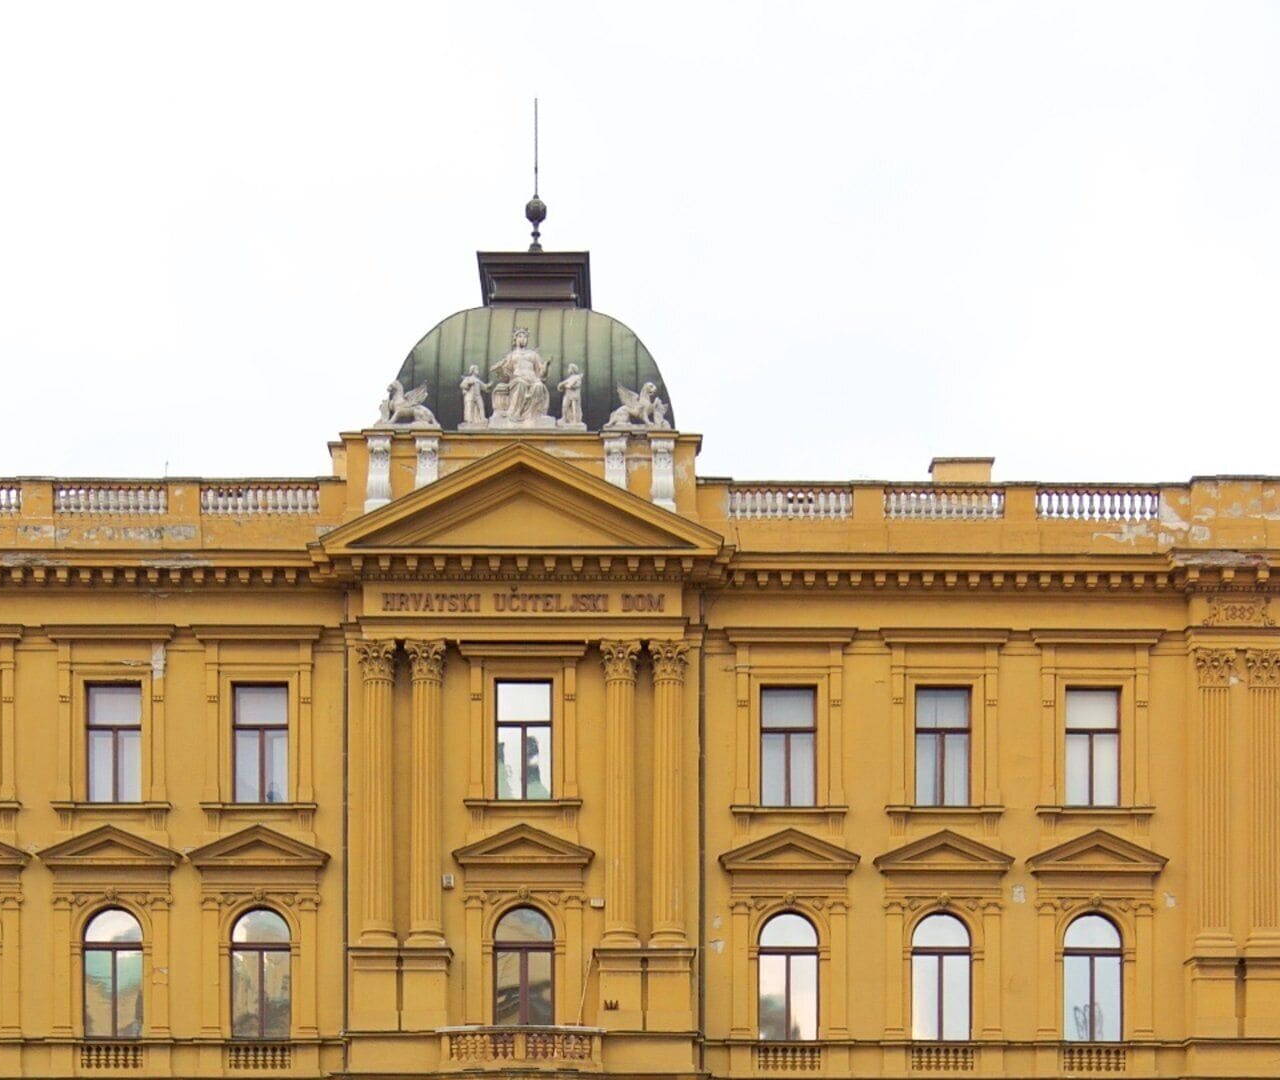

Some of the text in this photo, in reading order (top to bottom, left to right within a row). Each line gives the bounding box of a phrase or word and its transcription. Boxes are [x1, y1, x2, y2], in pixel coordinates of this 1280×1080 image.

[382, 585, 665, 612] HRVATSKI UČITELJSKI DOM
[1224, 605, 1255, 621] 1889
